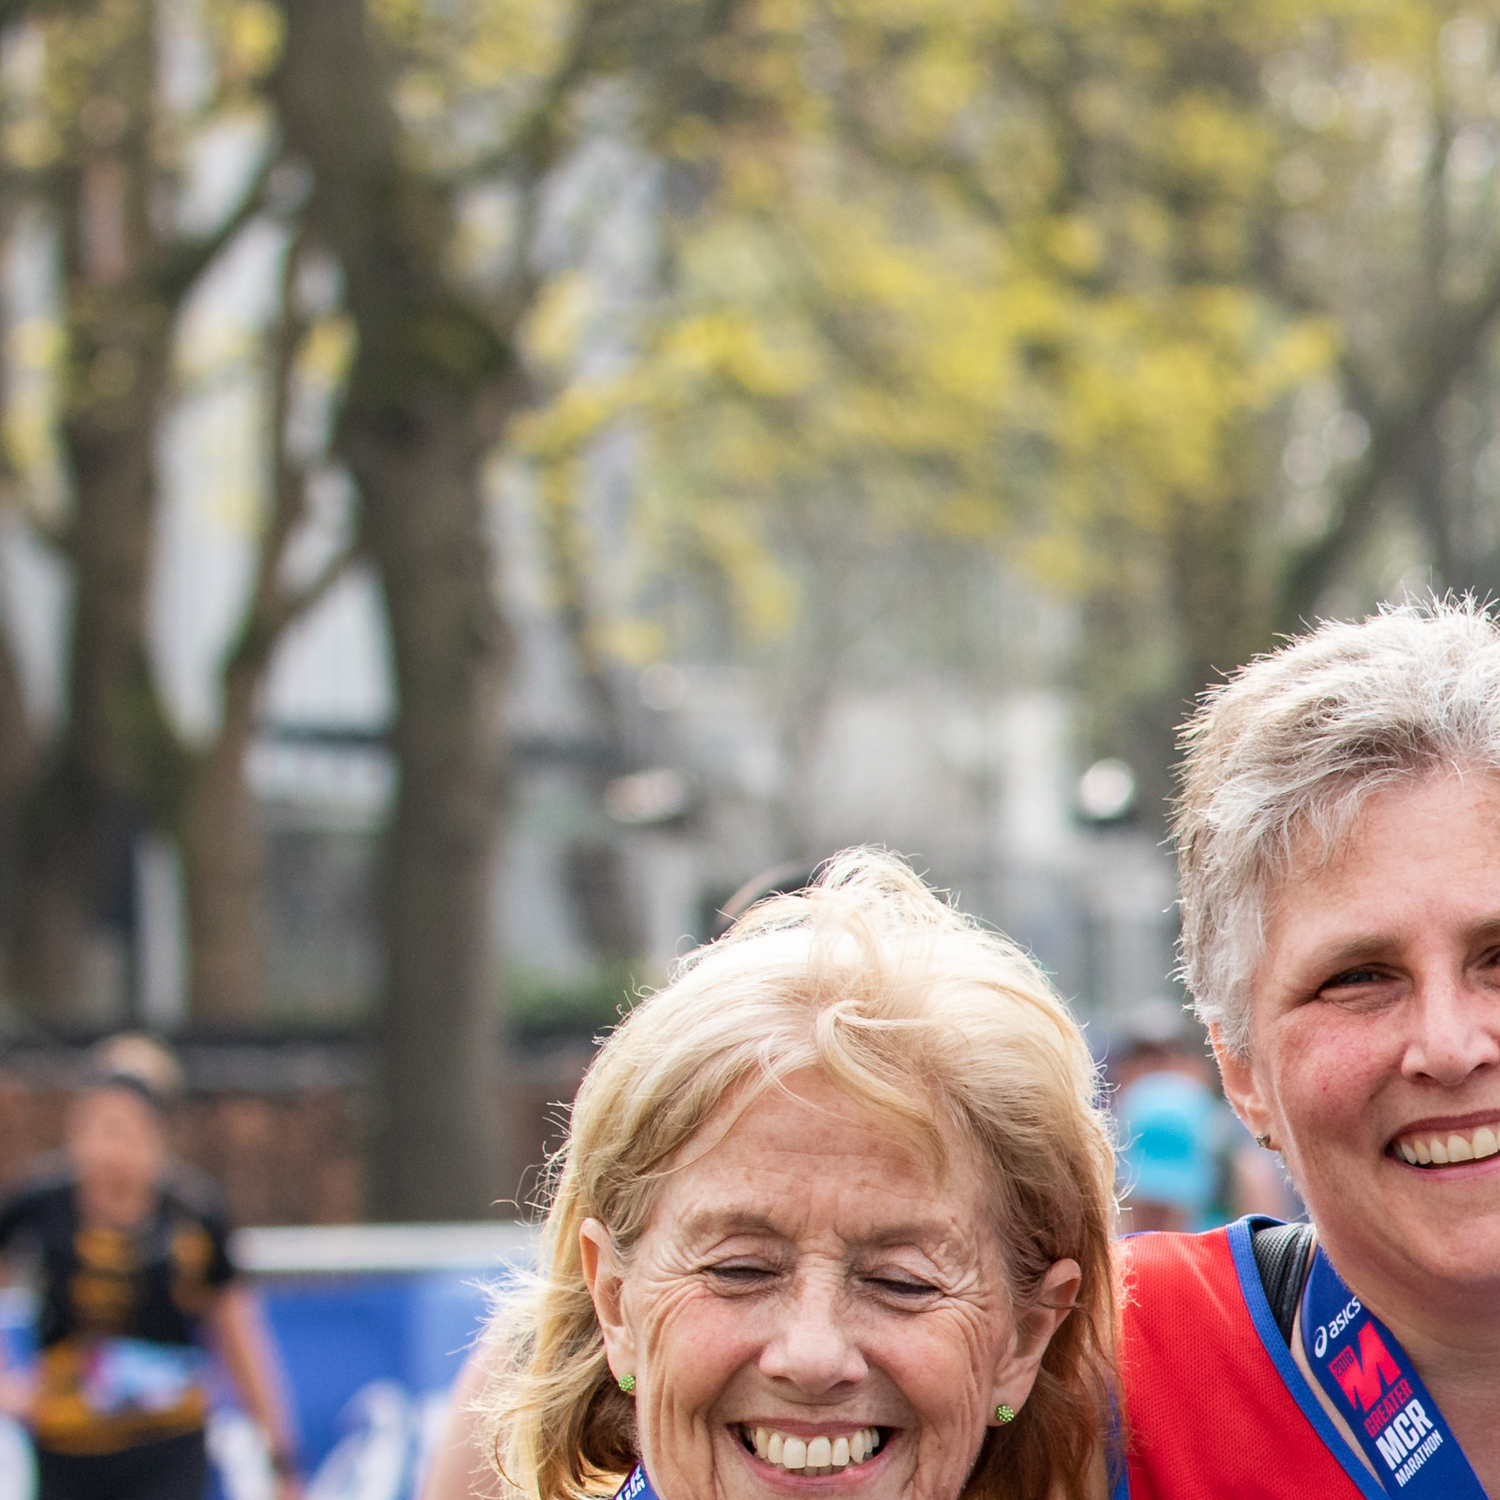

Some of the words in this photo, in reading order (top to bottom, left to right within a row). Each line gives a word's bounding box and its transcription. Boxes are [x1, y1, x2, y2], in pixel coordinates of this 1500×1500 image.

[1332, 1348, 1355, 1377] 2019
[1364, 1378, 1414, 1438] GREATER
[1374, 1397, 1434, 1472] MCR
[1394, 1428, 1445, 1488] MARATHON
